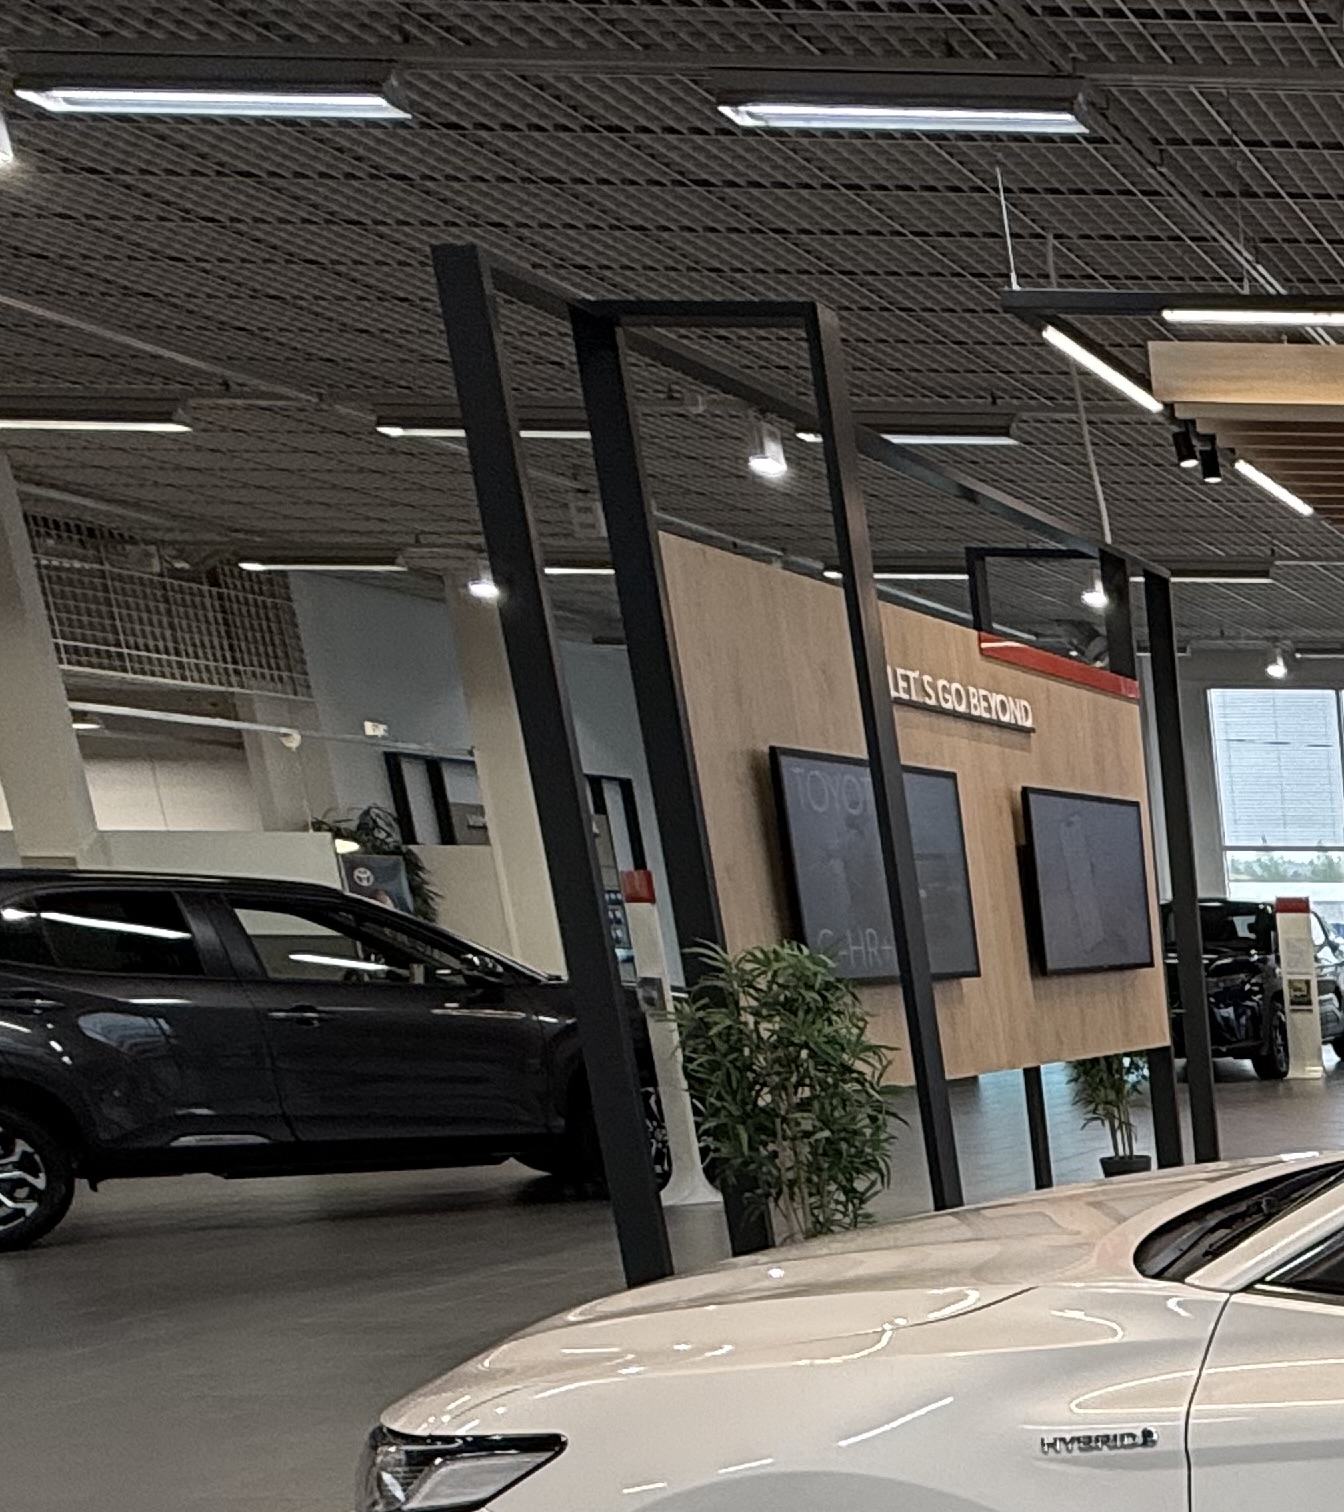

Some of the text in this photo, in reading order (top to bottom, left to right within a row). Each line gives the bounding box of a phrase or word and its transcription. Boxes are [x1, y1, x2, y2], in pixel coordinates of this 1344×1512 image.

[936, 678, 966, 713] GO
[967, 685, 1033, 727] BEYOND
[1040, 1432, 1139, 1455] HYBRID
